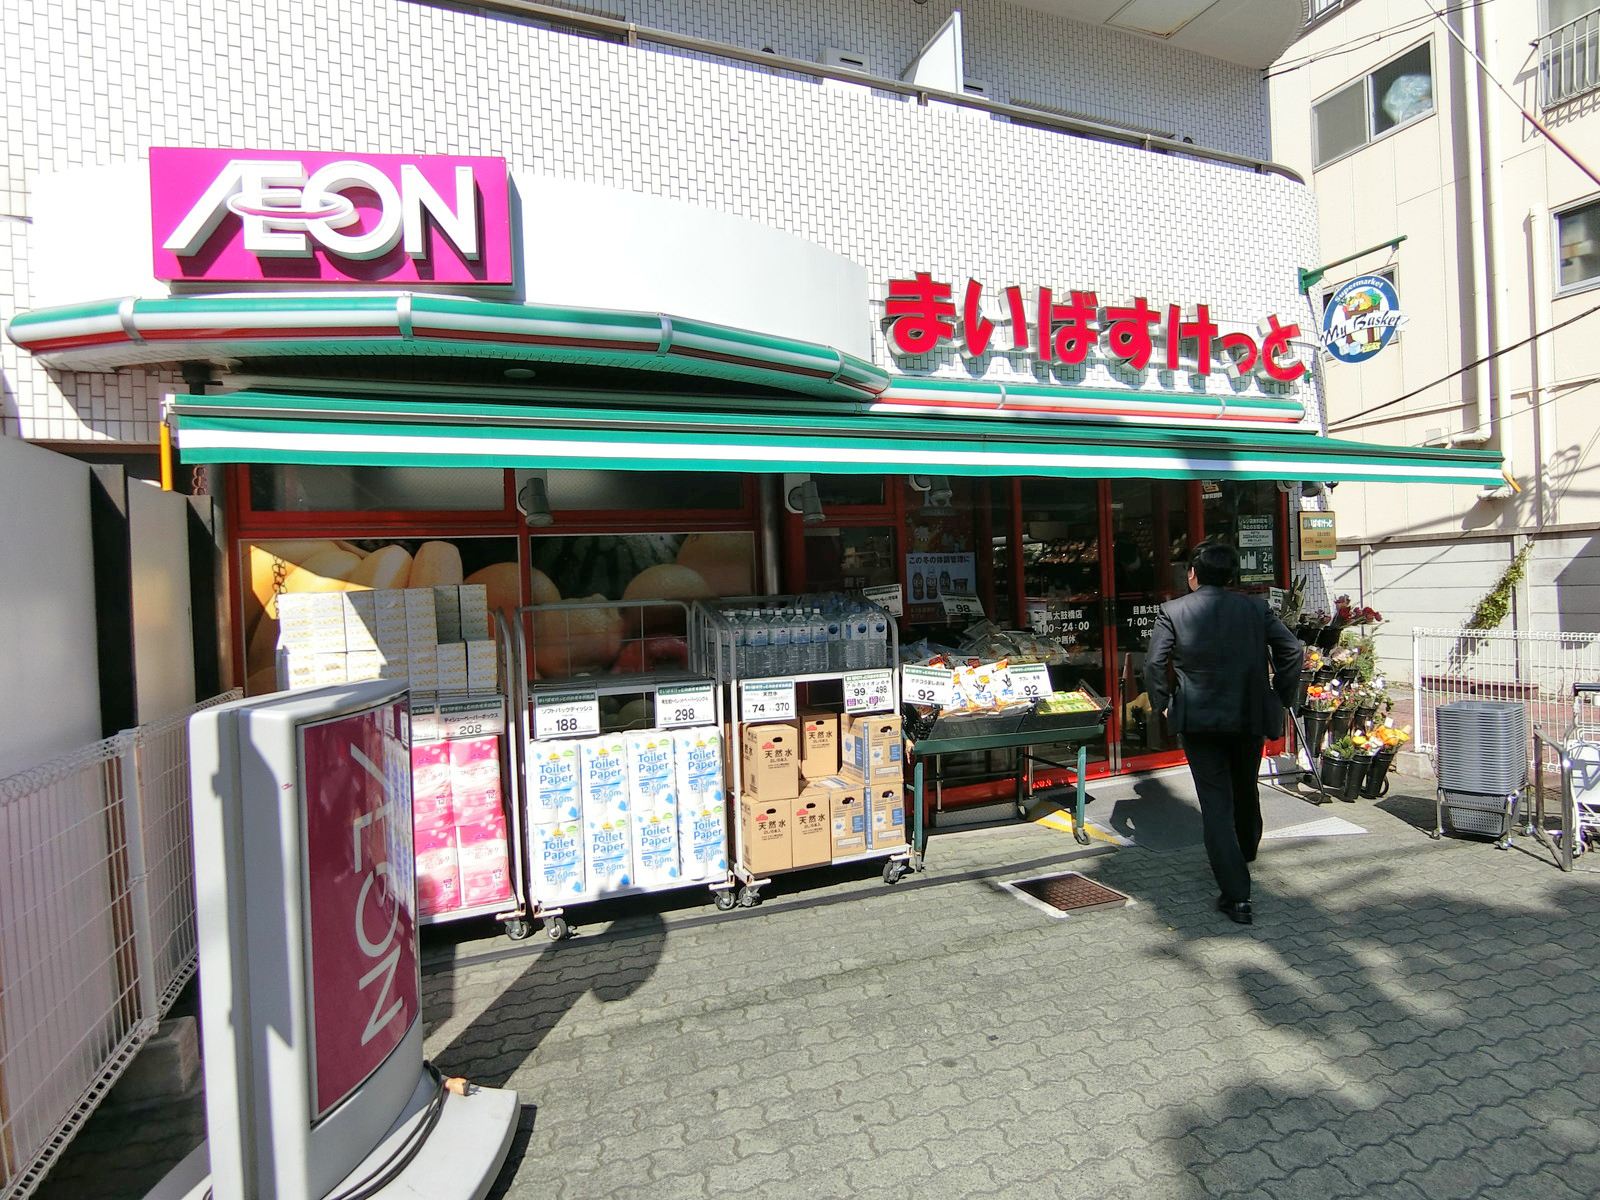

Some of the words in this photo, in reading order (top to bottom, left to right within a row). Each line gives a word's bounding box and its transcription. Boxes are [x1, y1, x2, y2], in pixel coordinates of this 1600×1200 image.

[1334, 278, 1384, 303] Supermarket
[885, 272, 1306, 382] まいばすけっと
[1320, 324, 1347, 346] My
[1354, 311, 1402, 331] Basket
[956, 604, 971, 613] 98
[854, 688, 866, 696] 99
[875, 686, 887, 694] 498
[918, 689, 935, 701] 92
[1024, 685, 1039, 696] 92
[752, 703, 765, 713] 74
[775, 702, 790, 712] 370
[675, 708, 695, 721] 298
[459, 724, 482, 735] 208
[556, 718, 577, 731] 188
[808, 730, 833, 740] 天然水
[638, 751, 667, 763] Toilet
[687, 749, 715, 761] Toilet
[765, 748, 793, 759] 天然水
[539, 763, 571, 774] Toilet
[589, 758, 620, 769] Toilet
[638, 762, 669, 773] Paper
[688, 760, 718, 771] Paper
[540, 774, 573, 786] Paper
[590, 768, 622, 780] Paper
[592, 793, 601, 801] 12
[693, 818, 720, 830] Toilet
[758, 819, 786, 831] 天然水
[799, 813, 826, 825] 天然水
[592, 831, 623, 843] Toilet
[641, 825, 671, 837] Toilet
[693, 828, 722, 840] Paper
[543, 838, 575, 850] Toilet
[593, 842, 625, 853] Paper
[641, 836, 673, 847] Paper
[544, 849, 577, 861] Paper
[546, 874, 554, 882] 12
